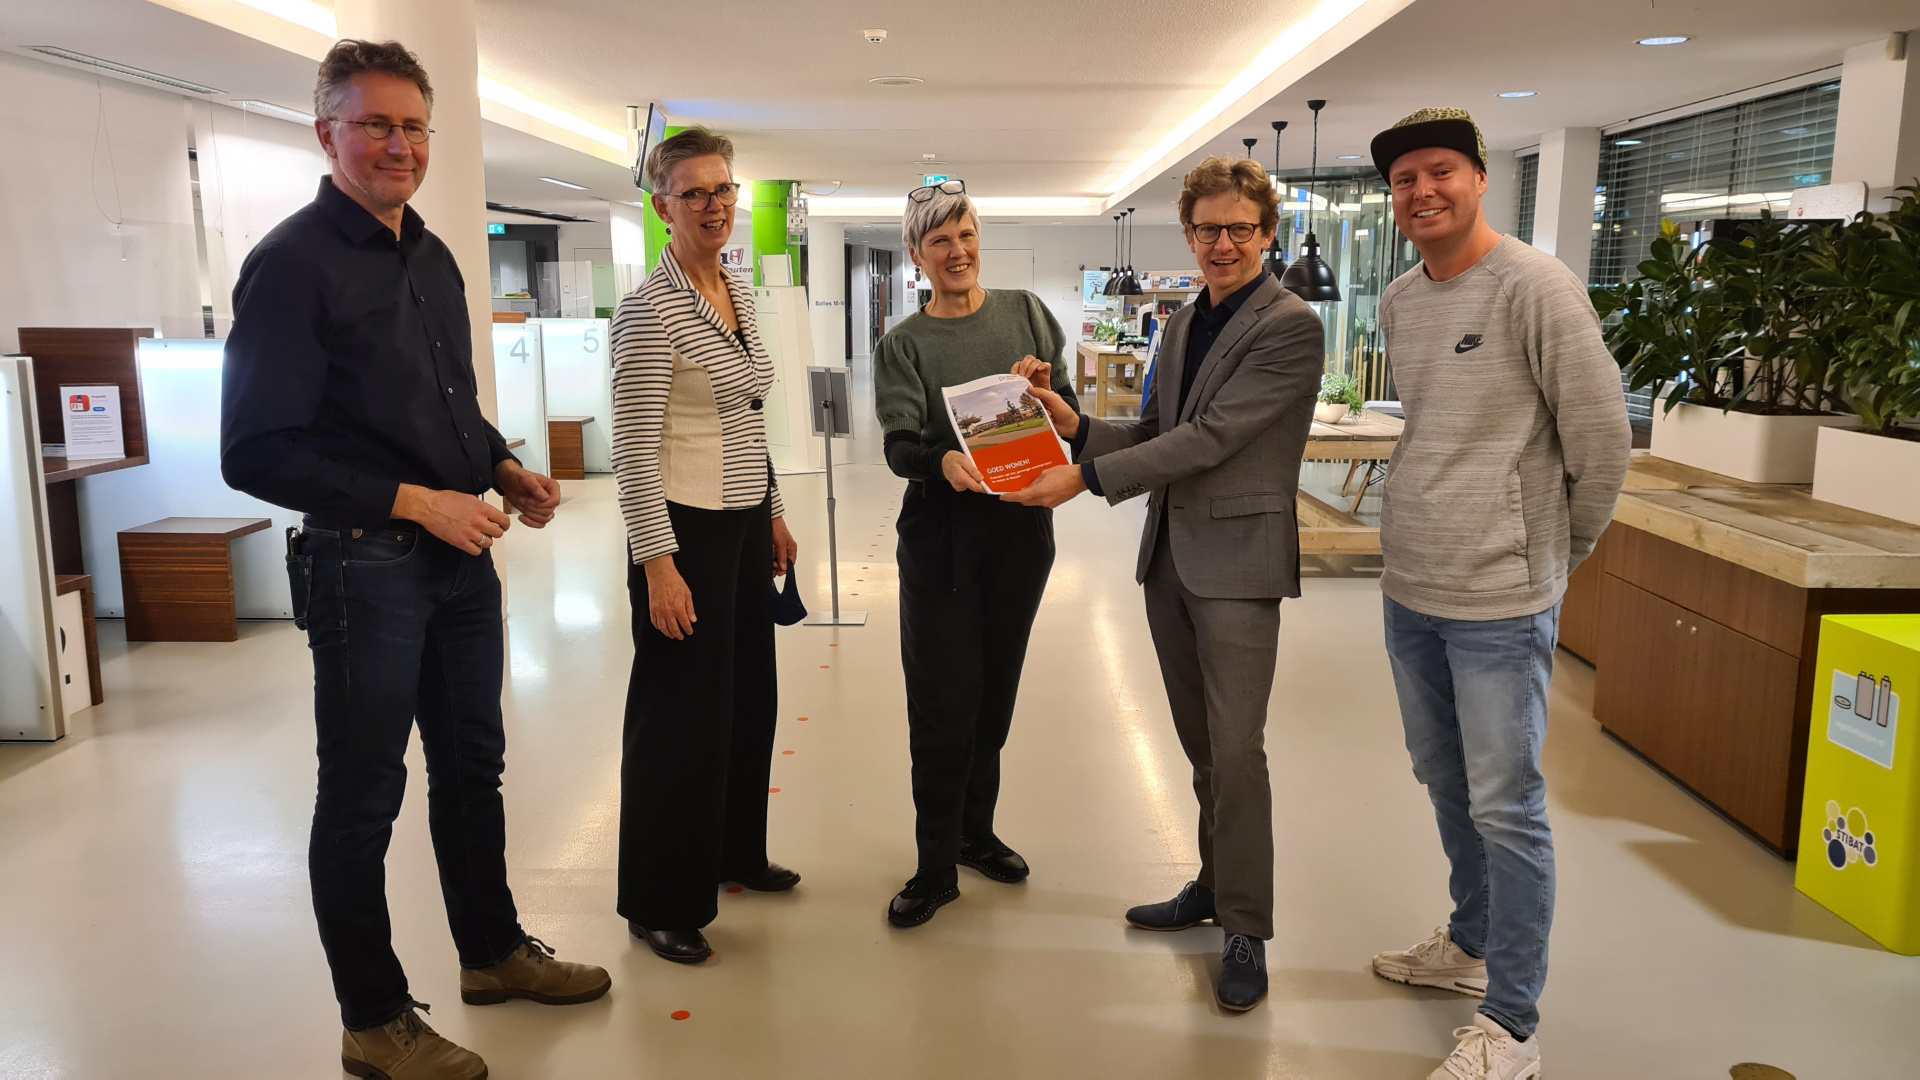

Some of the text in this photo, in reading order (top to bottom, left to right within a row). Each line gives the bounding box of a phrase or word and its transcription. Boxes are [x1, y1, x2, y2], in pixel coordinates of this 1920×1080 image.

[509, 335, 530, 363] 4
[583, 328, 600, 353] 5
[1461, 333, 1483, 345] NIKE
[986, 465, 1005, 474] GOED
[1836, 829, 1864, 853] STIBAT
